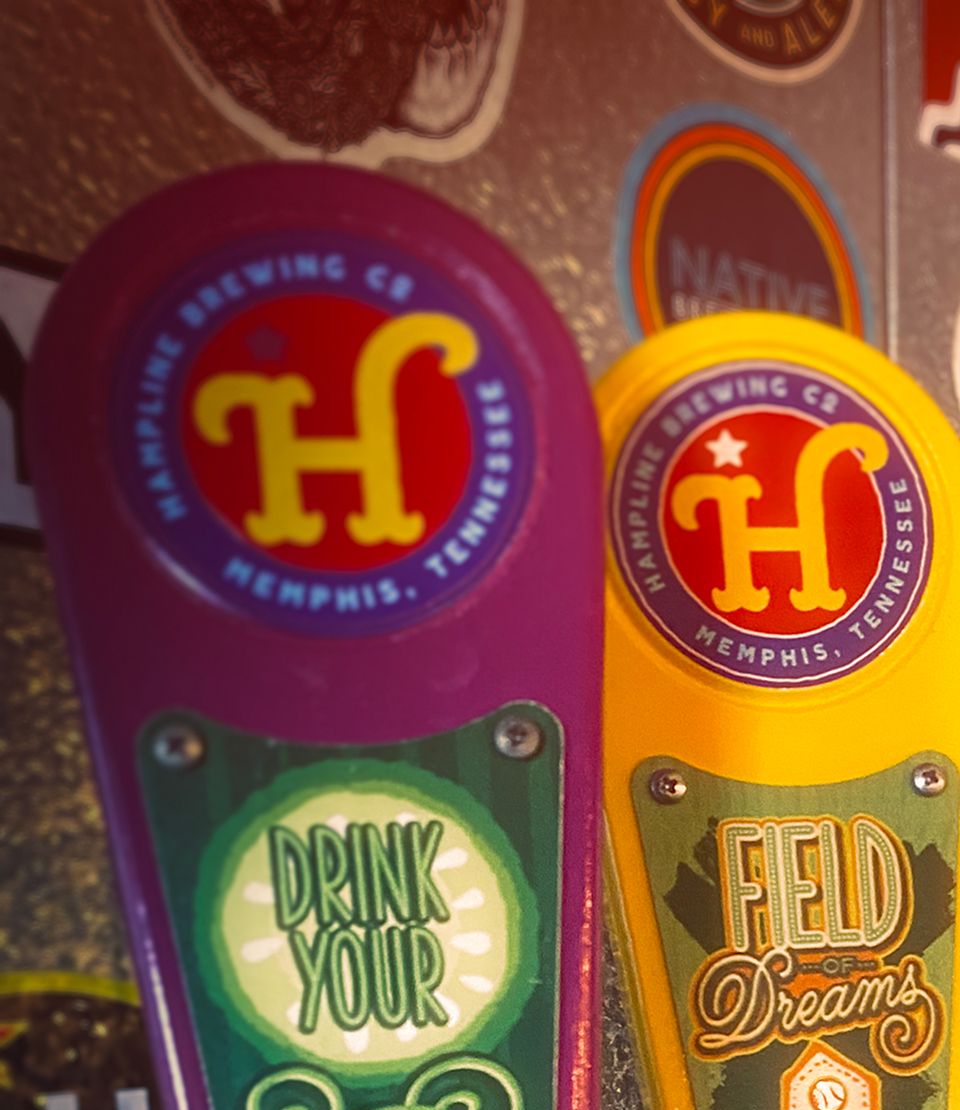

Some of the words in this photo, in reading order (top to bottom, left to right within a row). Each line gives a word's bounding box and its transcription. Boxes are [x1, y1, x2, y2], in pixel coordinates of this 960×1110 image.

[740, 24, 775, 48] AND
[671, 235, 830, 319] NATIVE
[135, 333, 187, 522] HAMPLINE
[179, 253, 347, 328] BREWING
[193, 311, 479, 547] H
[222, 556, 416, 612] MEMPHIS,
[424, 381, 512, 579] TENNESSEE
[627, 444, 666, 594] HAMPLINE
[659, 375, 789, 438] BREWING
[671, 422, 889, 612] H
[695, 625, 842, 668] MEMPHIS,
[849, 478, 913, 641] TENNESSEE
[268, 820, 451, 932] DRINK
[720, 816, 911, 952] FIELD
[288, 923, 449, 1035] YOUR
[697, 948, 939, 1064] Dreams
[822, 957, 854, 974] OF
